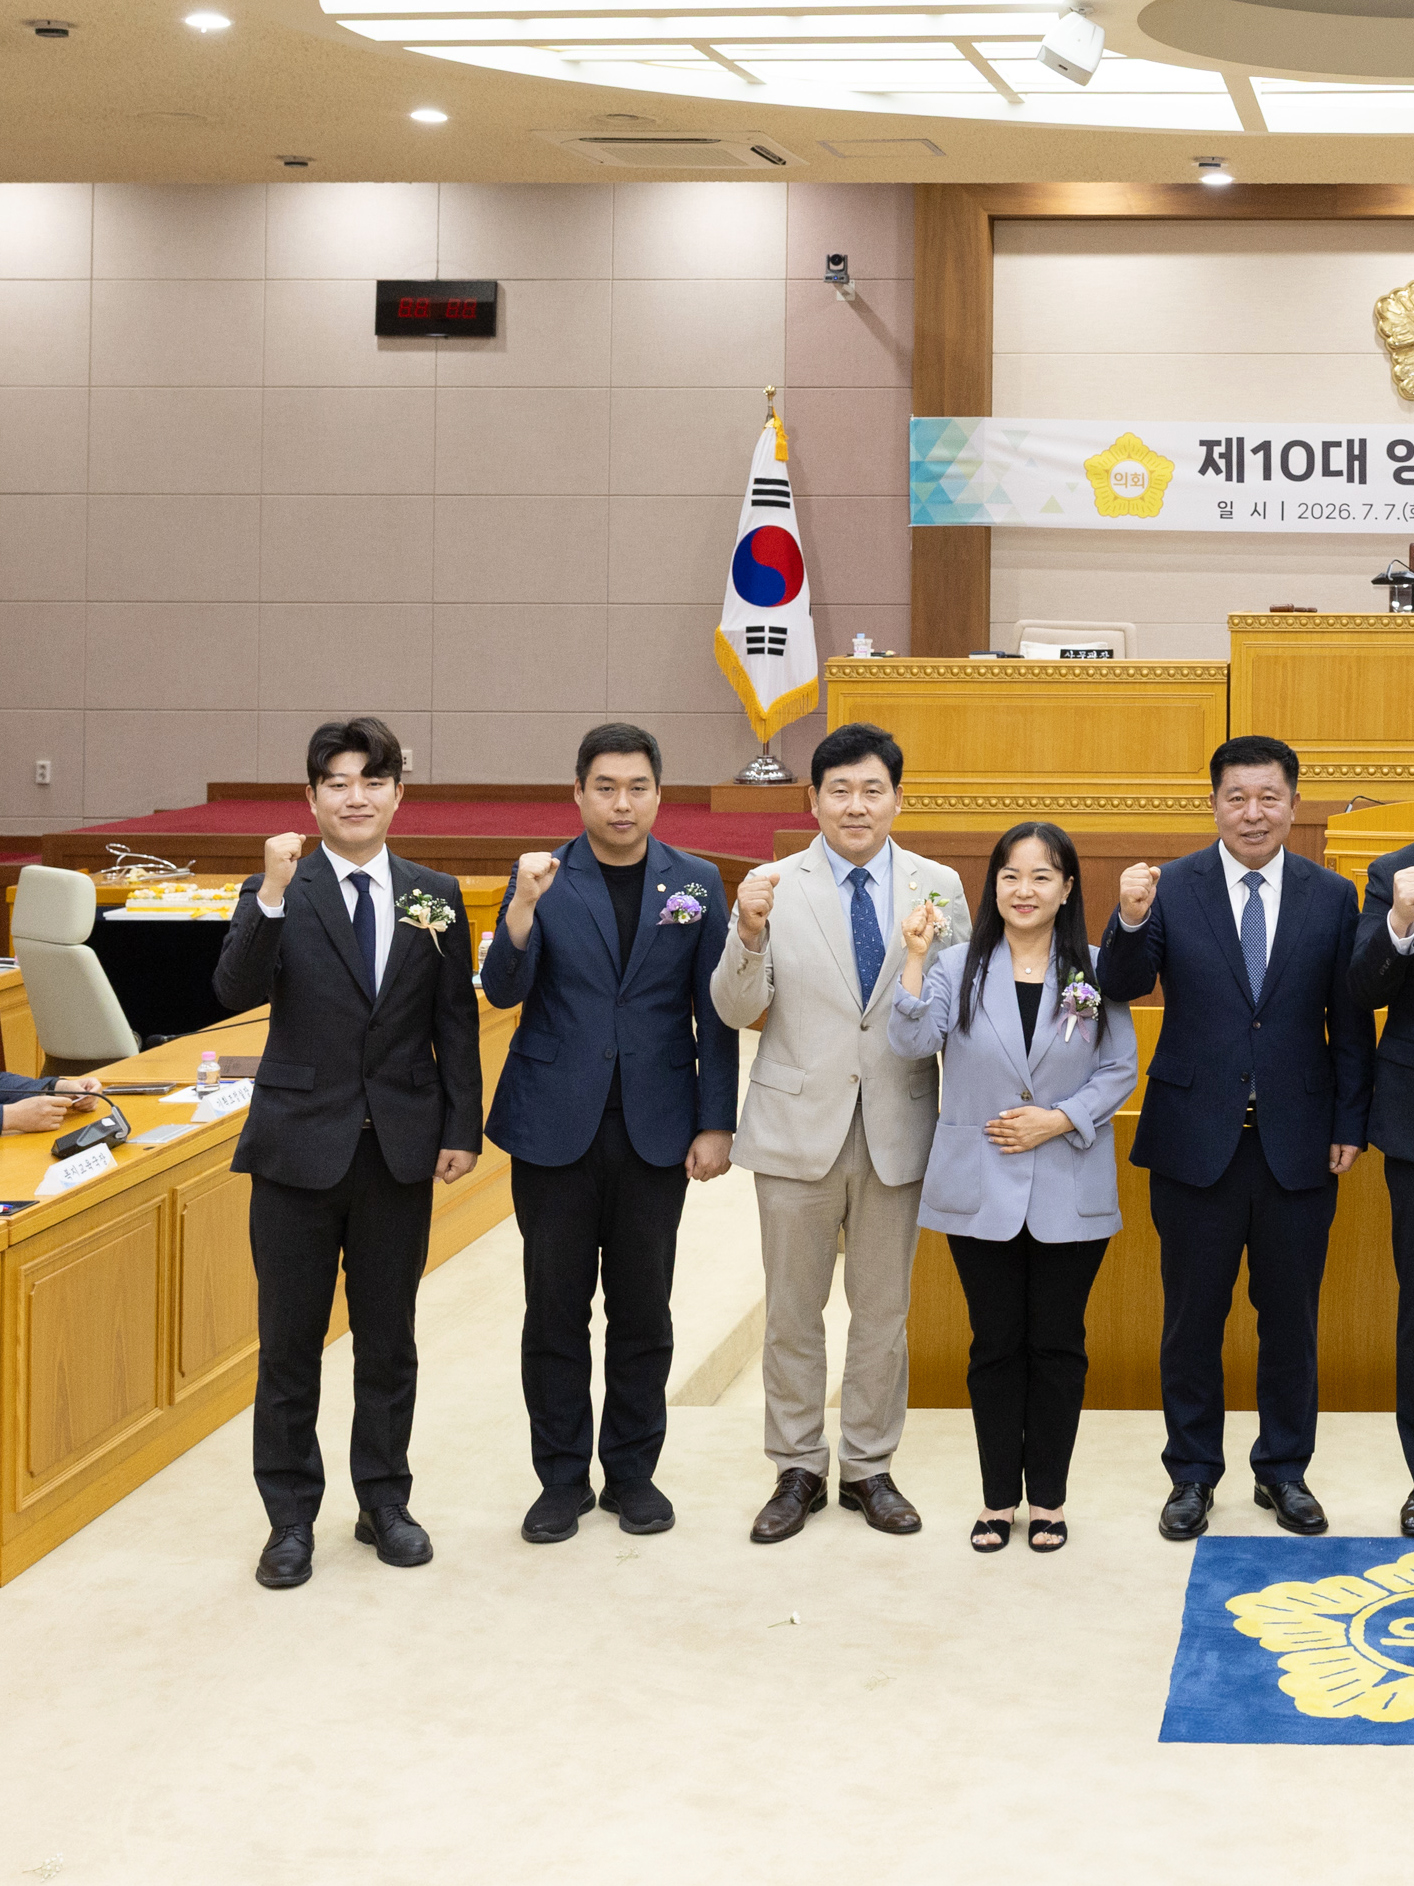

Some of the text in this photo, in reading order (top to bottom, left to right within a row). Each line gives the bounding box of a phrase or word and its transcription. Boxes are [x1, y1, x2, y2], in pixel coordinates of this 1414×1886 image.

[1198, 436, 1367, 485] 제10대
[1112, 471, 1146, 489] 의회
[63, 1152, 108, 1180] 복지교육국장
